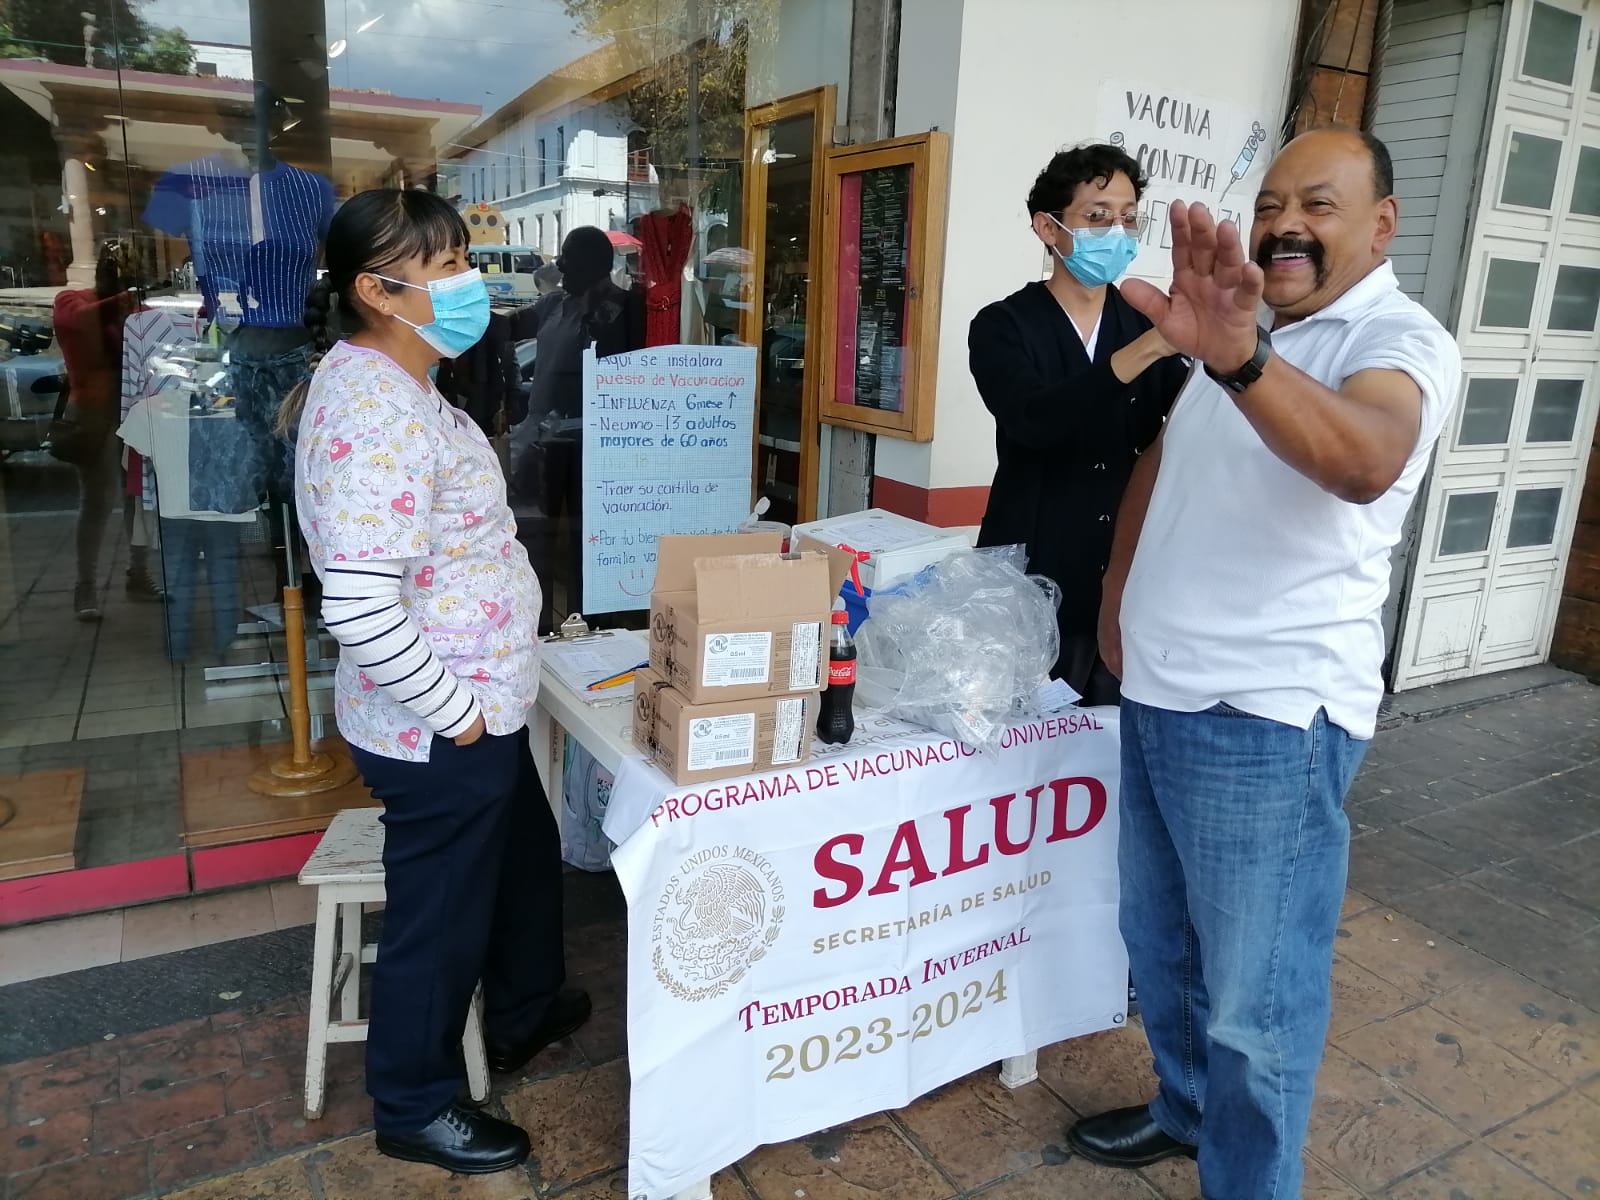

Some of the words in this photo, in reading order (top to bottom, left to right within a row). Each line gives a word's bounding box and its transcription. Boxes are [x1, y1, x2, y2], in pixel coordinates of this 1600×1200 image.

[1126, 91, 1211, 140] VACUNA
[1136, 143, 1216, 192] CONTRA
[596, 374, 646, 390] puesto
[652, 374, 665, 386] de
[640, 355, 657, 367] se
[600, 436, 654, 448] mayores
[661, 434, 675, 447] de
[680, 434, 697, 447] 60
[686, 414, 736, 430] adultos
[639, 485, 653, 496] su
[657, 480, 699, 495] cartilla
[705, 482, 719, 494] de
[597, 551, 635, 567] familia
[600, 530, 616, 546] Por
[623, 530, 634, 546] tu
[651, 773, 801, 828] PROGRAMA
[807, 765, 840, 791] DE
[1001, 713, 1104, 749] UNIVERSAL
[813, 776, 1107, 908] SALUD
[652, 875, 680, 943] ESTADOS
[680, 844, 728, 875] UNIDOS
[732, 845, 785, 903] MEXICANOS
[813, 904, 953, 954] SECRETARÍA
[960, 892, 985, 913] DE
[992, 870, 1052, 902] SALUD
[738, 975, 912, 1032] TEMPORADA
[922, 927, 1031, 984] INVERNAL
[766, 968, 1008, 1084] 2023-2024
